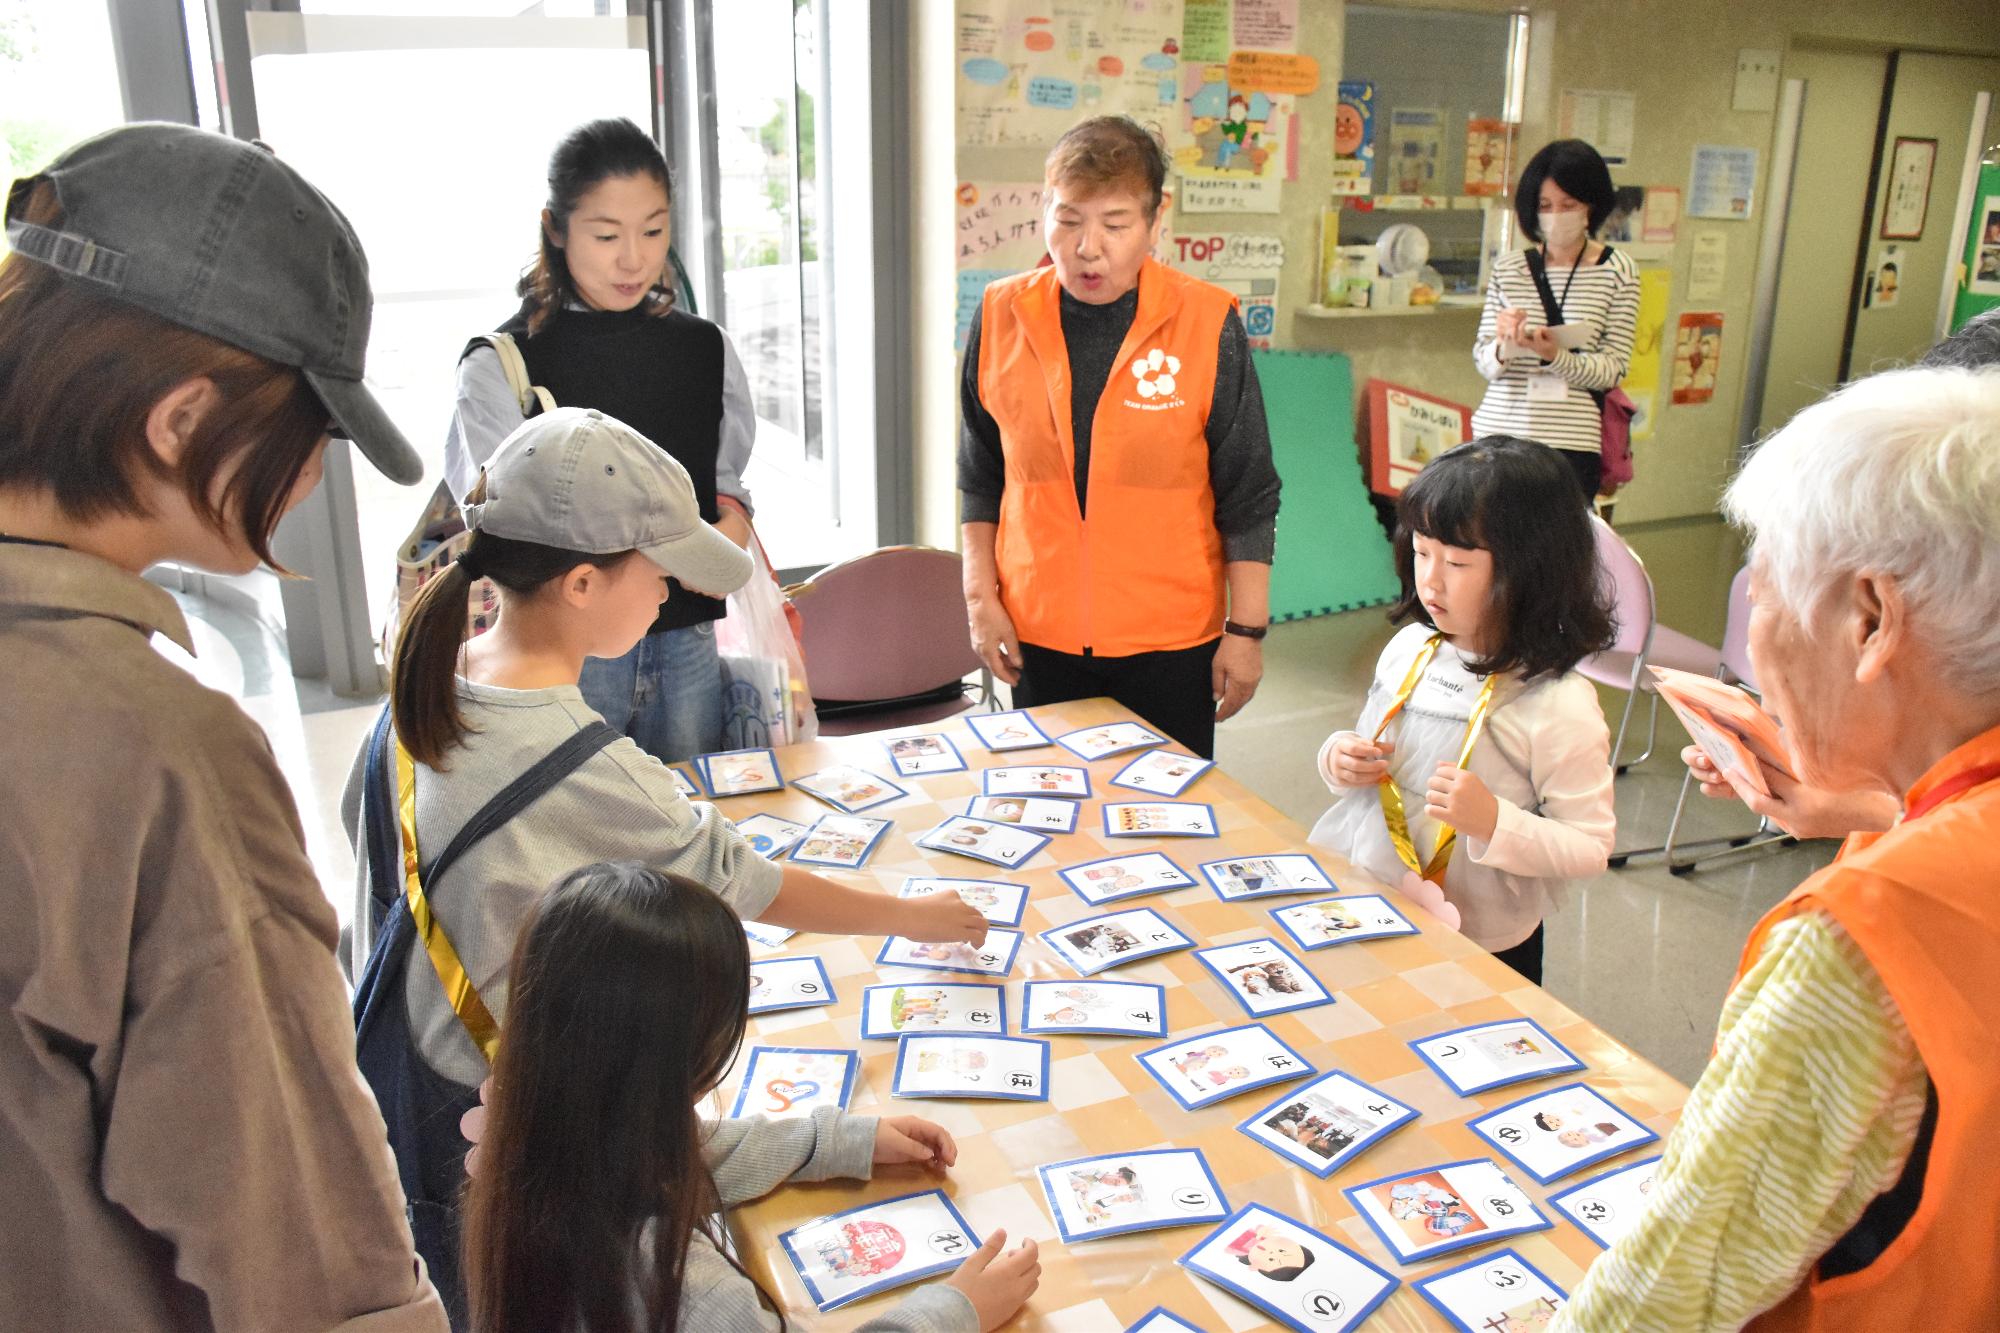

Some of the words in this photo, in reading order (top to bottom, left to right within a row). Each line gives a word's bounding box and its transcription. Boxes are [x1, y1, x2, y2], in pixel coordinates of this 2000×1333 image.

[1173, 236, 1225, 262] TOP
[1410, 405, 1458, 429] かみしばい
[1152, 933, 1168, 941] と
[981, 955, 999, 965] か
[801, 984, 817, 993] の
[971, 1012, 991, 1023] む
[1131, 1012, 1153, 1022] す
[1441, 1046, 1458, 1056] し
[1268, 1056, 1292, 1068] は
[1012, 1074, 1032, 1087] ほ
[1368, 1104, 1390, 1115] よ
[1499, 1128, 1521, 1142] ゆ
[1180, 1194, 1204, 1204] り
[1490, 1199, 1514, 1215] ぬ
[1583, 1204, 1605, 1221] な
[935, 1234, 960, 1252] れ
[1494, 1271, 1521, 1287] ふ
[1314, 1295, 1339, 1315] ひ
